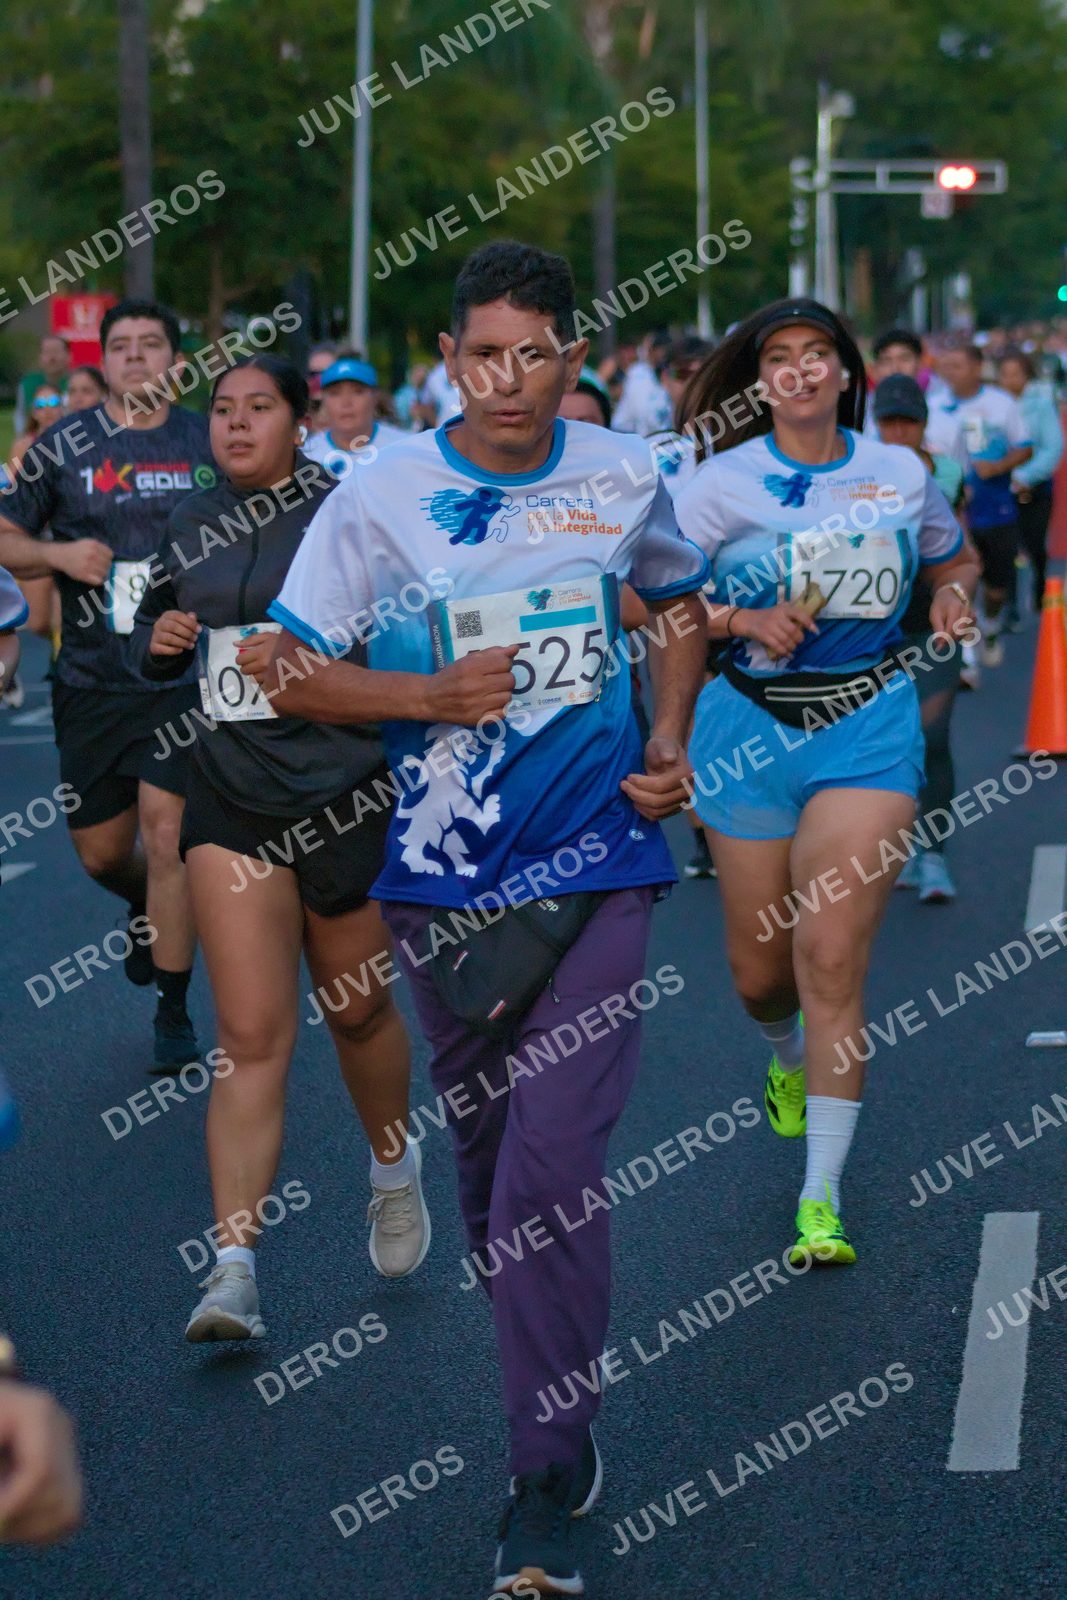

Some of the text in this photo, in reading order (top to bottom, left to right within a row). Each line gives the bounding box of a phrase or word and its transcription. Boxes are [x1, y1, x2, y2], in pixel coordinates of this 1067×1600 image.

[526, 495, 593, 509] Carrera
[566, 509, 597, 521] Vida
[800, 567, 898, 606] 1720
[467, 628, 605, 696] 525
